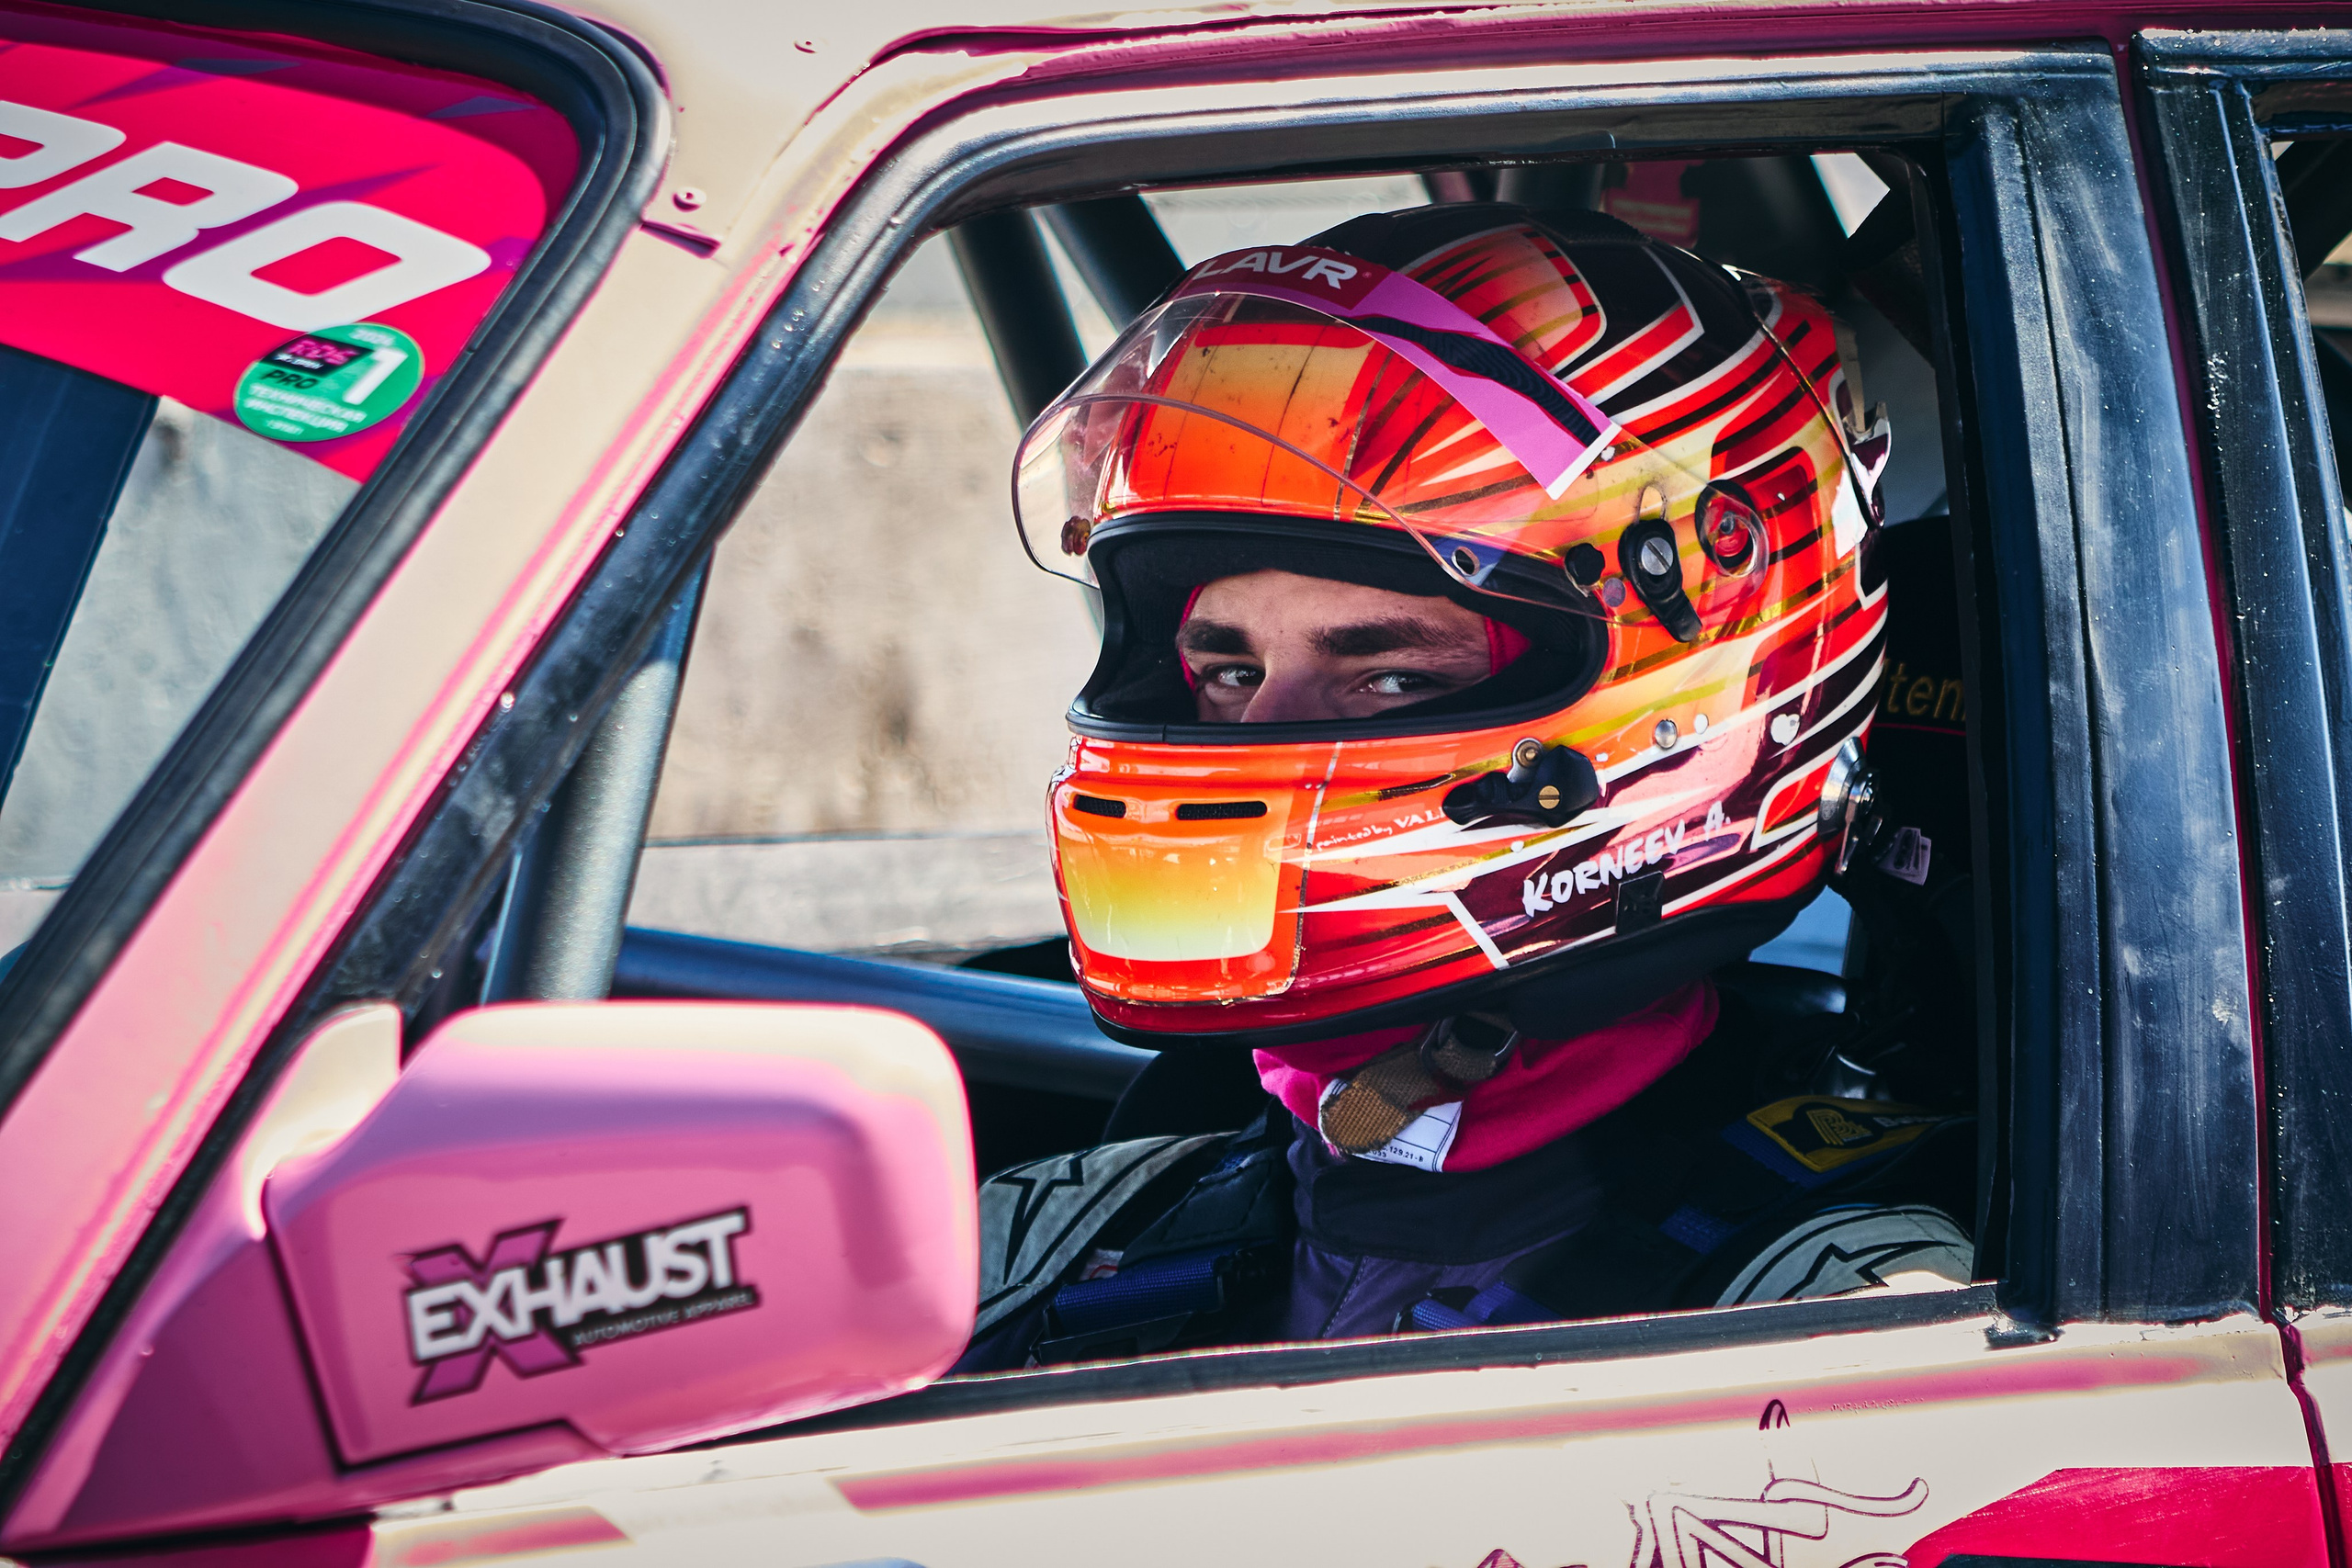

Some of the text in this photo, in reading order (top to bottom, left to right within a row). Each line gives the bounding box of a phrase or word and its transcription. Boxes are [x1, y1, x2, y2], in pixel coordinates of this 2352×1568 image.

[1193, 252, 1358, 290] LAVR
[261, 369, 320, 389] PRO
[342, 346, 409, 405] 1
[1521, 800, 1731, 918] KORNEEV A.
[408, 1212, 746, 1361] EXHAUST
[573, 1310, 680, 1345] AUTOMOTIVE
